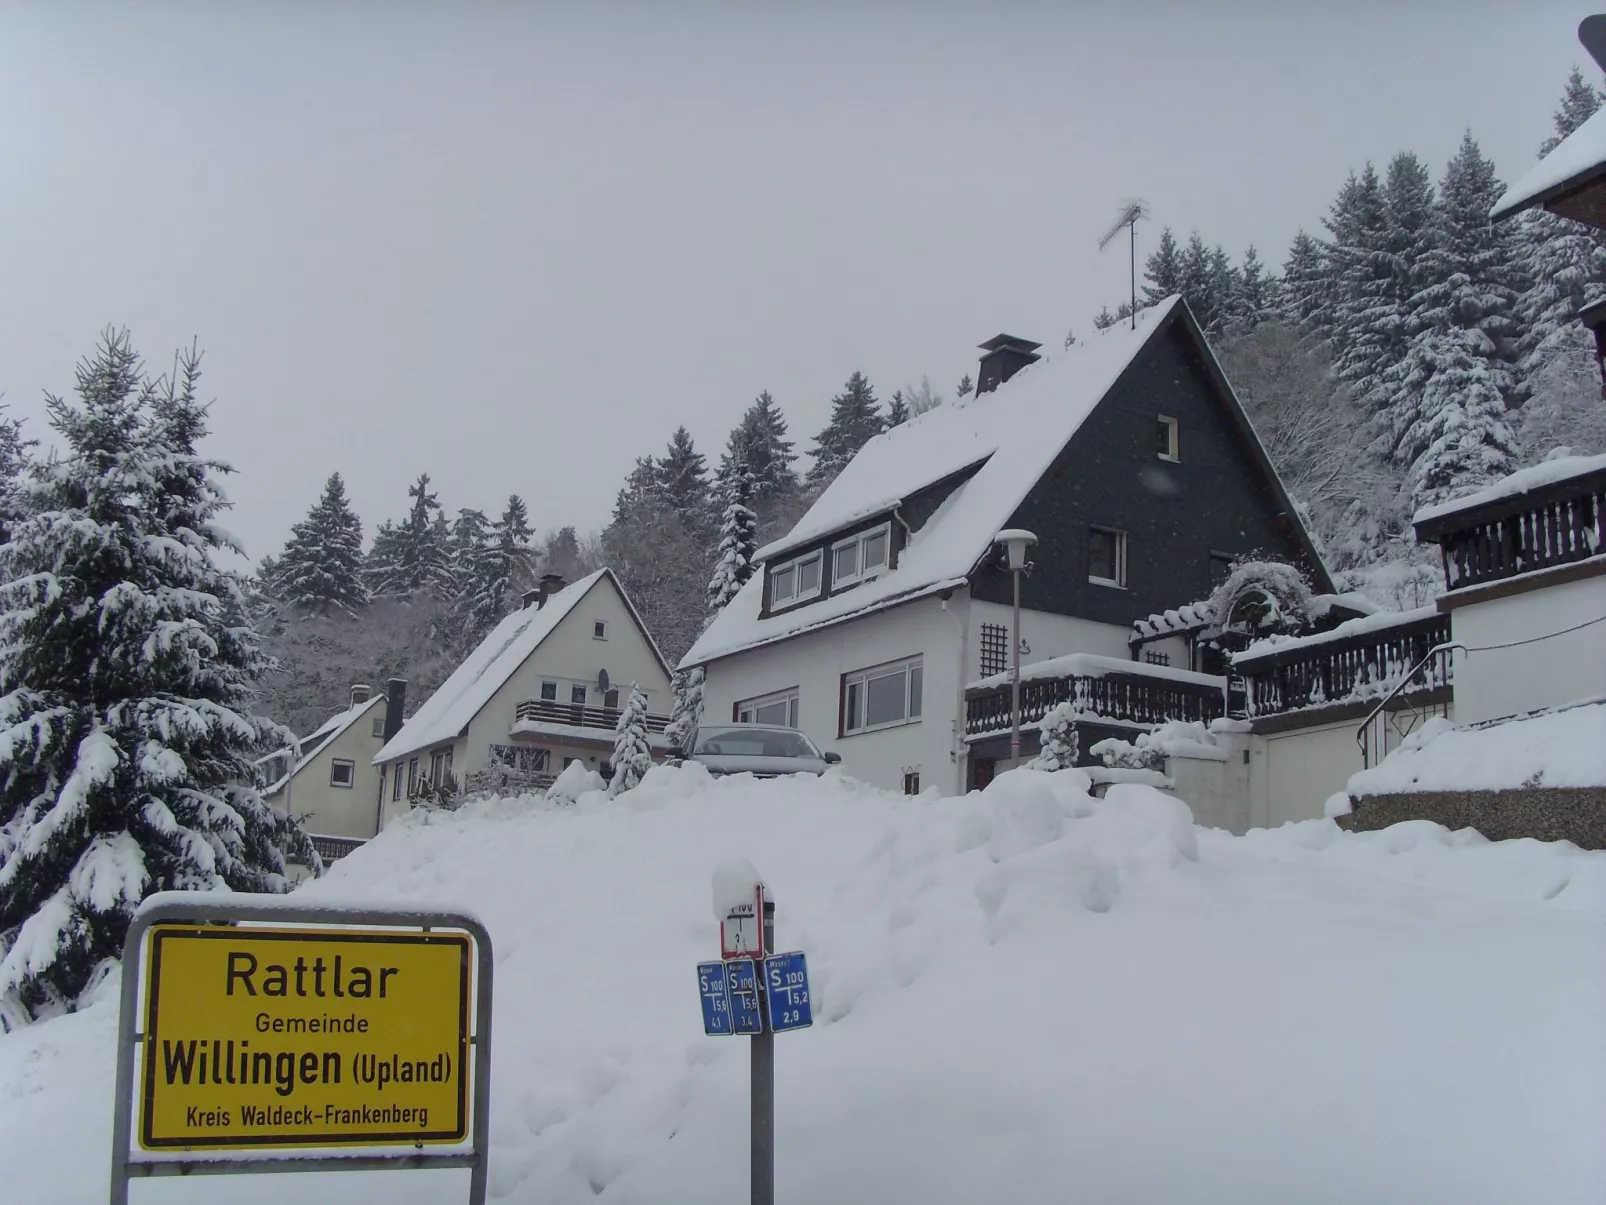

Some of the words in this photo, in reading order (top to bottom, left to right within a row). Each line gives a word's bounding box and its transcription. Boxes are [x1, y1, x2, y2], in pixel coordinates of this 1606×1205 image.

[226, 952, 399, 998] Rattlar
[730, 973, 738, 989] S
[740, 978, 753, 989] 100
[771, 970, 781, 986] S
[786, 972, 804, 984] 100
[701, 976, 708, 992] S
[711, 981, 723, 992] 100
[793, 992, 808, 1005] 5,2
[256, 1012, 369, 1034] Gemeinde
[784, 1011, 799, 1023] 2,9
[164, 1040, 341, 1096] Willingen
[353, 1052, 452, 1091] (Upland)
[186, 1105, 231, 1128] Kreis
[240, 1103, 428, 1128] Waldeck-Frankenberg
